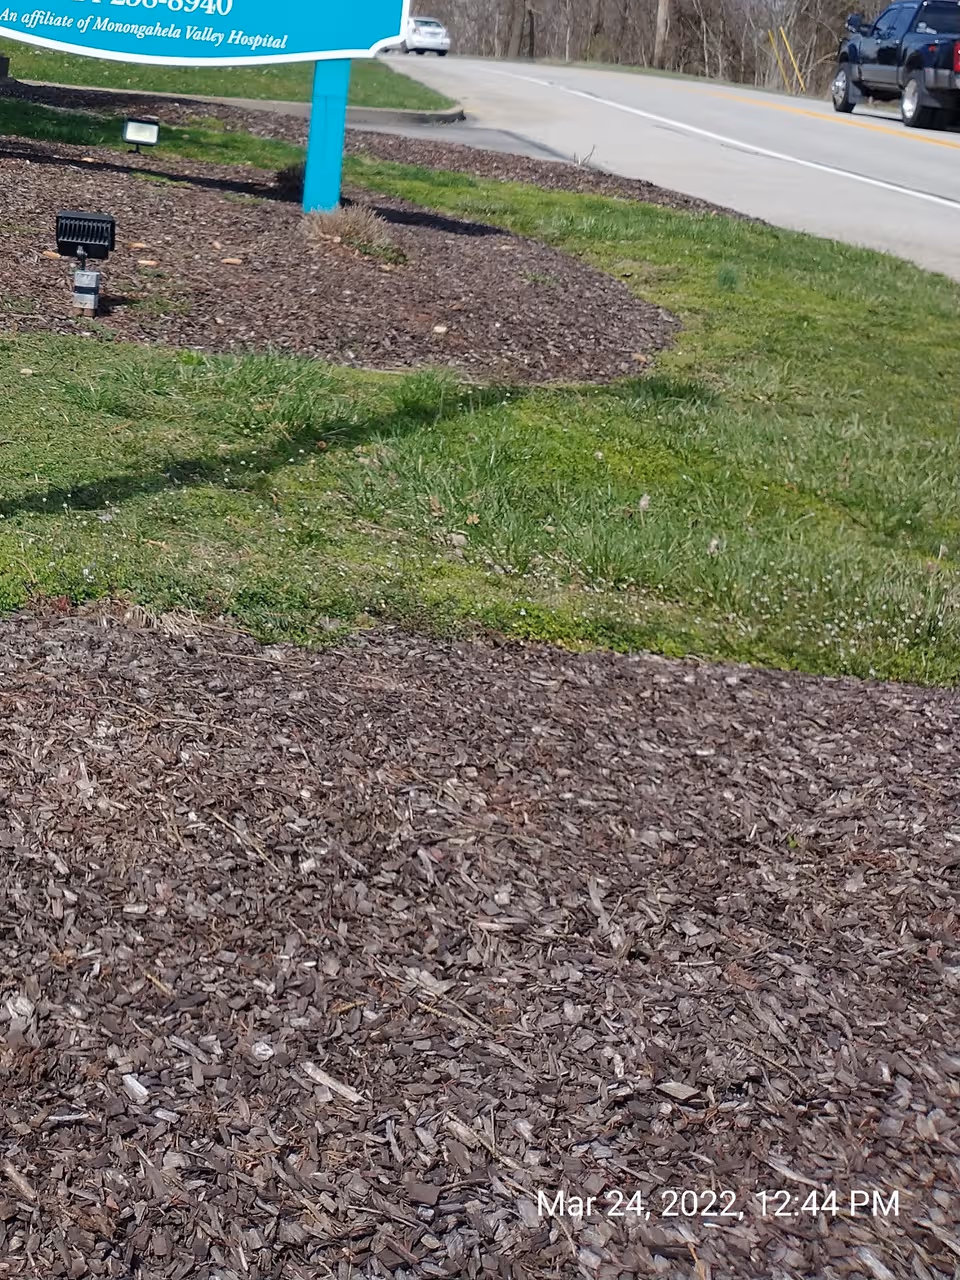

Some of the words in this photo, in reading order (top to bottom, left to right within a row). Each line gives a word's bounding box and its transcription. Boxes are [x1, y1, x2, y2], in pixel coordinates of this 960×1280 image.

[21, 10, 73, 28] affiliate
[77, 16, 92, 32] of
[93, 17, 182, 38] Monongahela
[186, 26, 224, 46] Valley
[228, 30, 287, 50] Hospital
